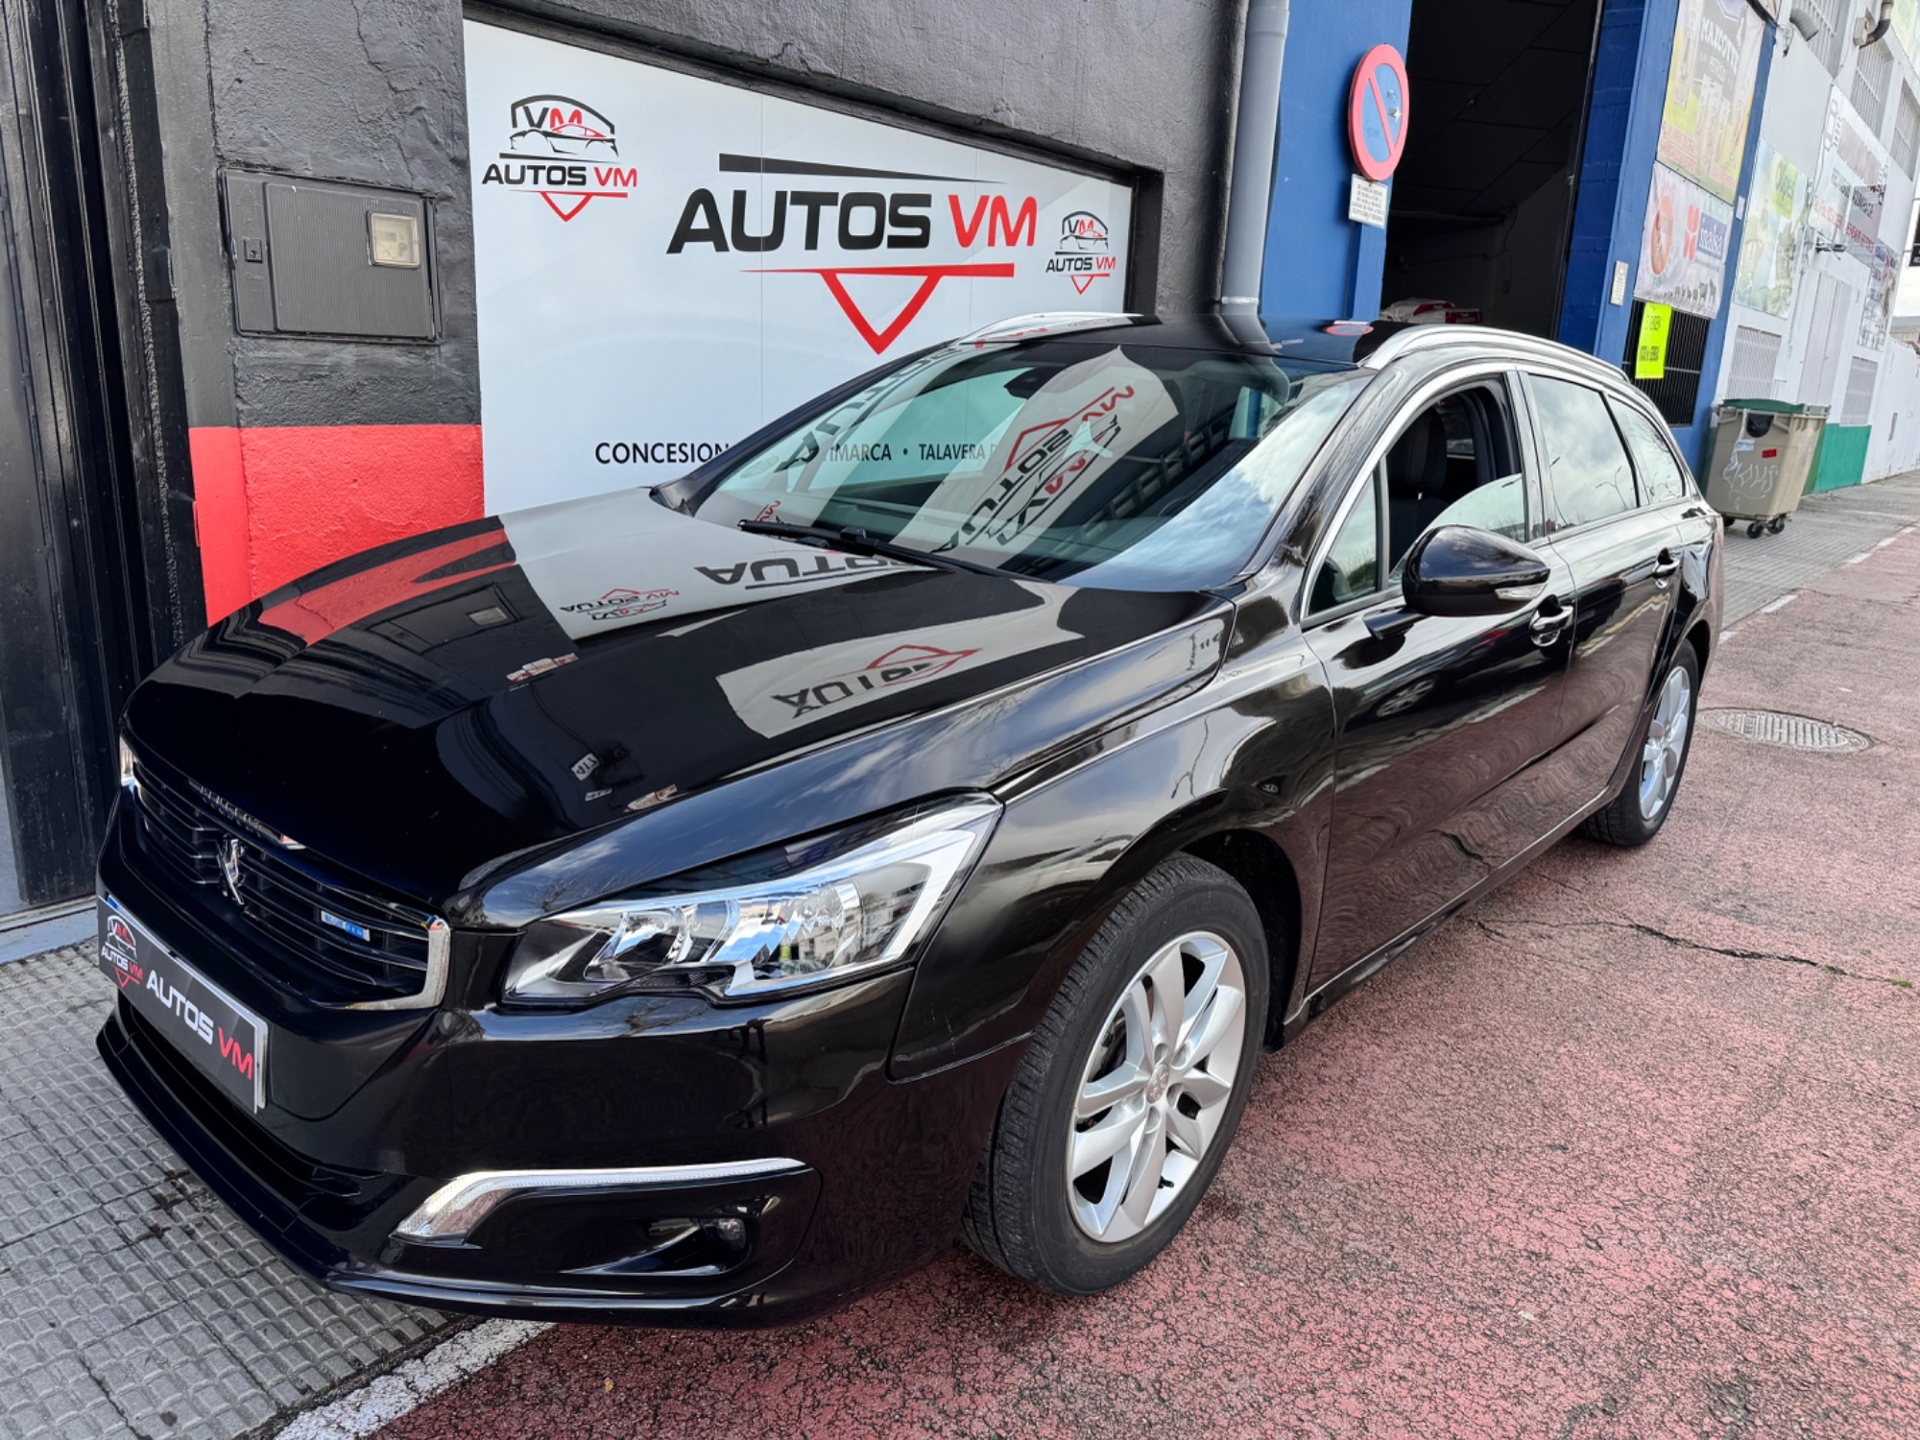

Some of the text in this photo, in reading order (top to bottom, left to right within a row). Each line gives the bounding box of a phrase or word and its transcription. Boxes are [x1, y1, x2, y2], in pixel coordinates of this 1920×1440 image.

[481, 163, 637, 188] AUTOS VM
[666, 187, 1038, 254] AUTOS VM
[1046, 256, 1117, 273] AUTOS VM
[919, 443, 985, 460] TALAVERA
[101, 945, 143, 980] AUTOS VM
[146, 970, 254, 1080] AUTOS VM
